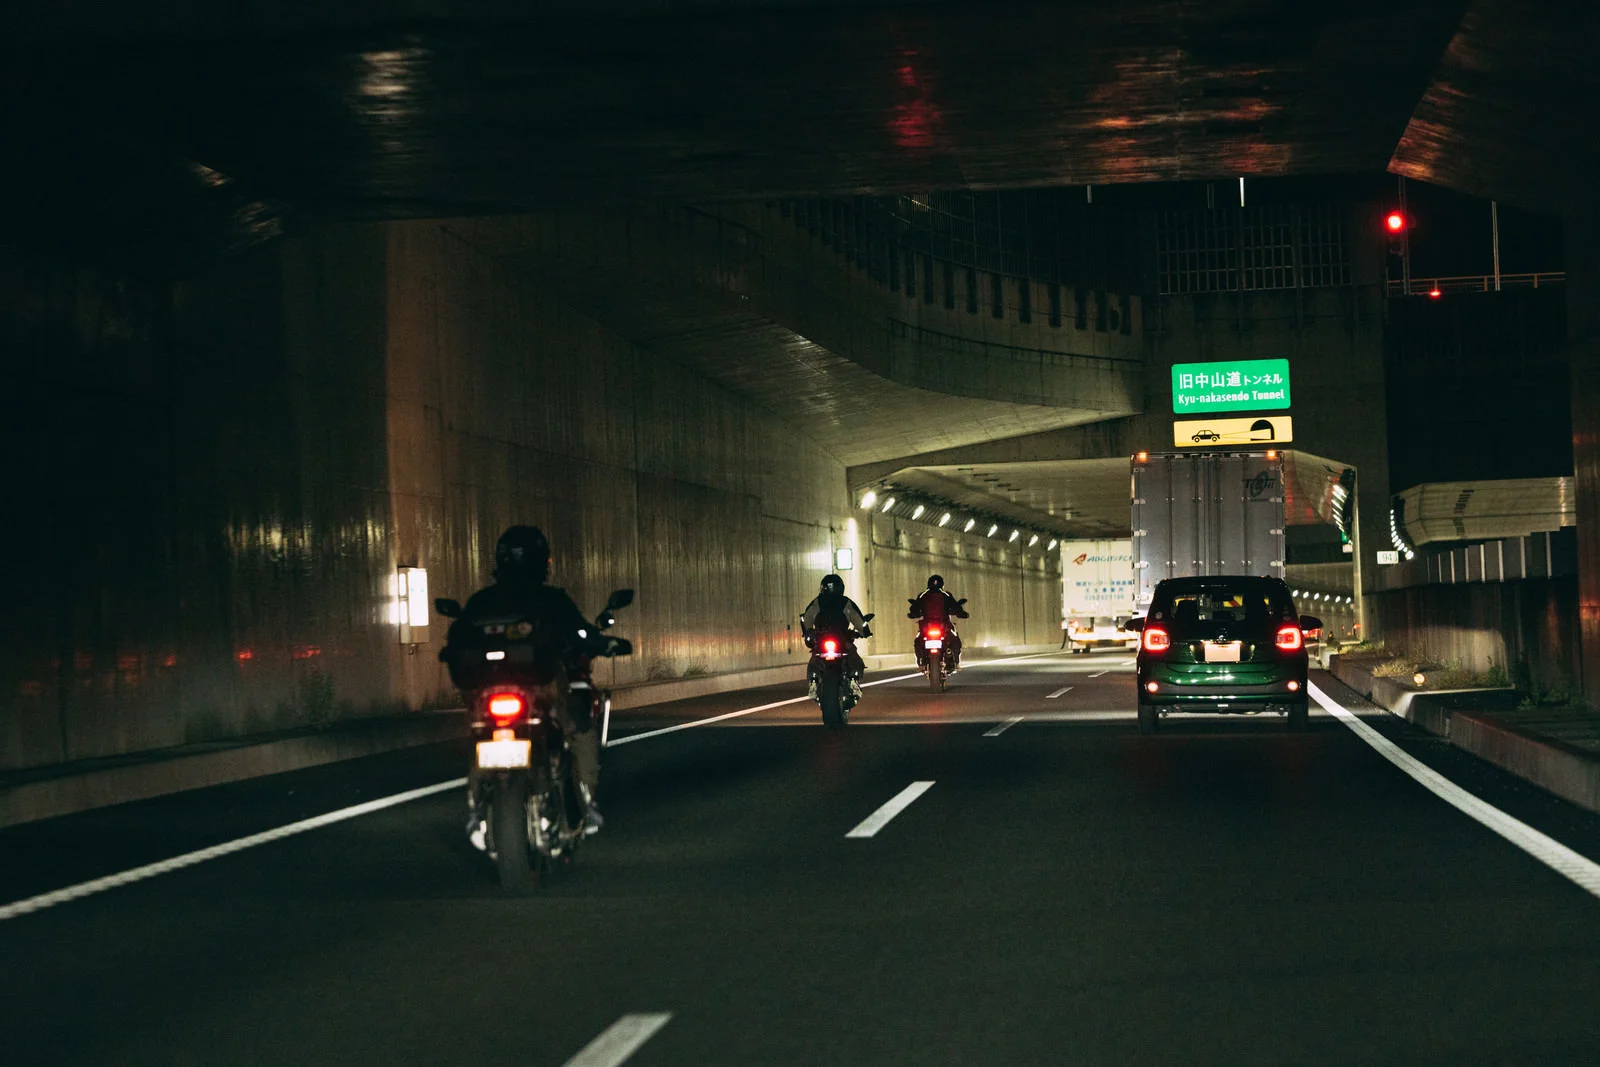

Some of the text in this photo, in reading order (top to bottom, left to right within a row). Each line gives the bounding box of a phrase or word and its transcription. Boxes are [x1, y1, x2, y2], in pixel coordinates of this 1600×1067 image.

[1179, 371, 1283, 389] 旧中山道トンネル
[1178, 389, 1285, 406] Kyu-nakasendo Tunnel
